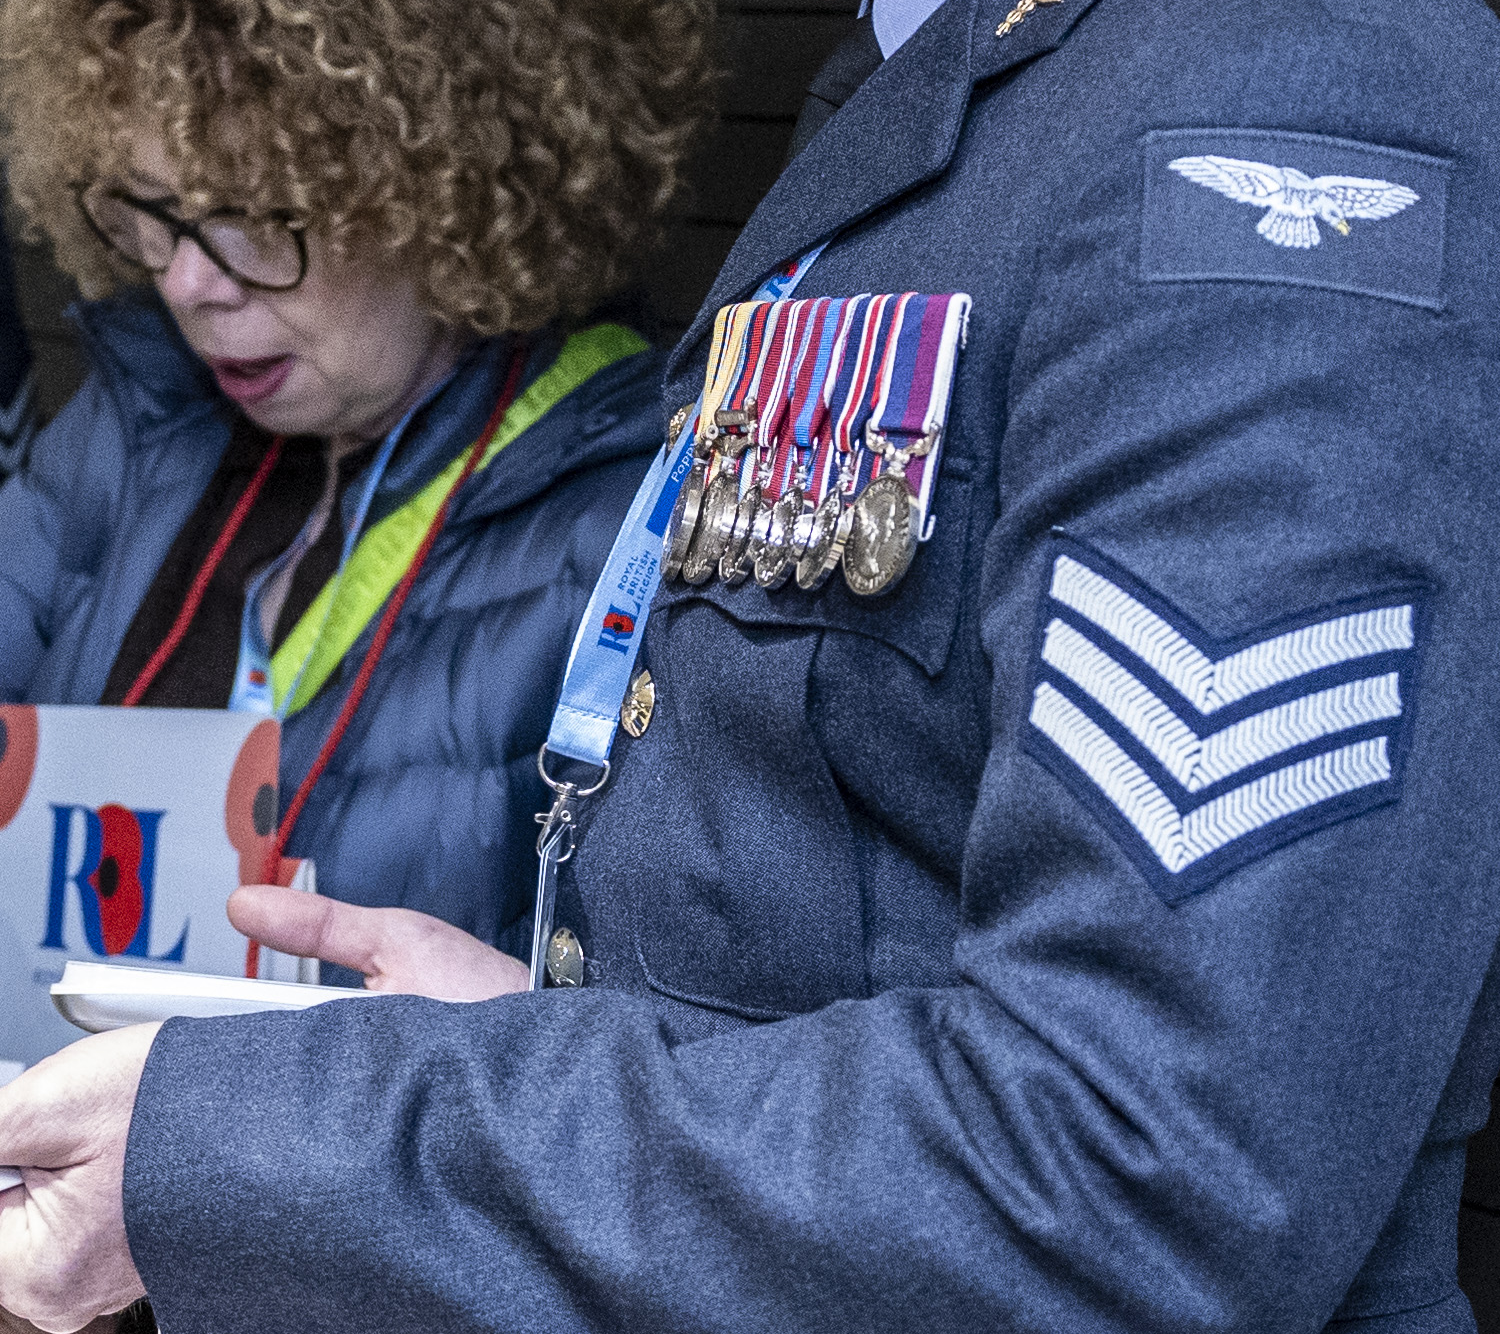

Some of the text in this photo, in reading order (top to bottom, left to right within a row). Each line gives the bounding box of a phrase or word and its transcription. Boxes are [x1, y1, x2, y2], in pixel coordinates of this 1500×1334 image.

[617, 555, 639, 591] ROYAL
[626, 550, 652, 597] BRITISH
[637, 557, 658, 601] LEGION
